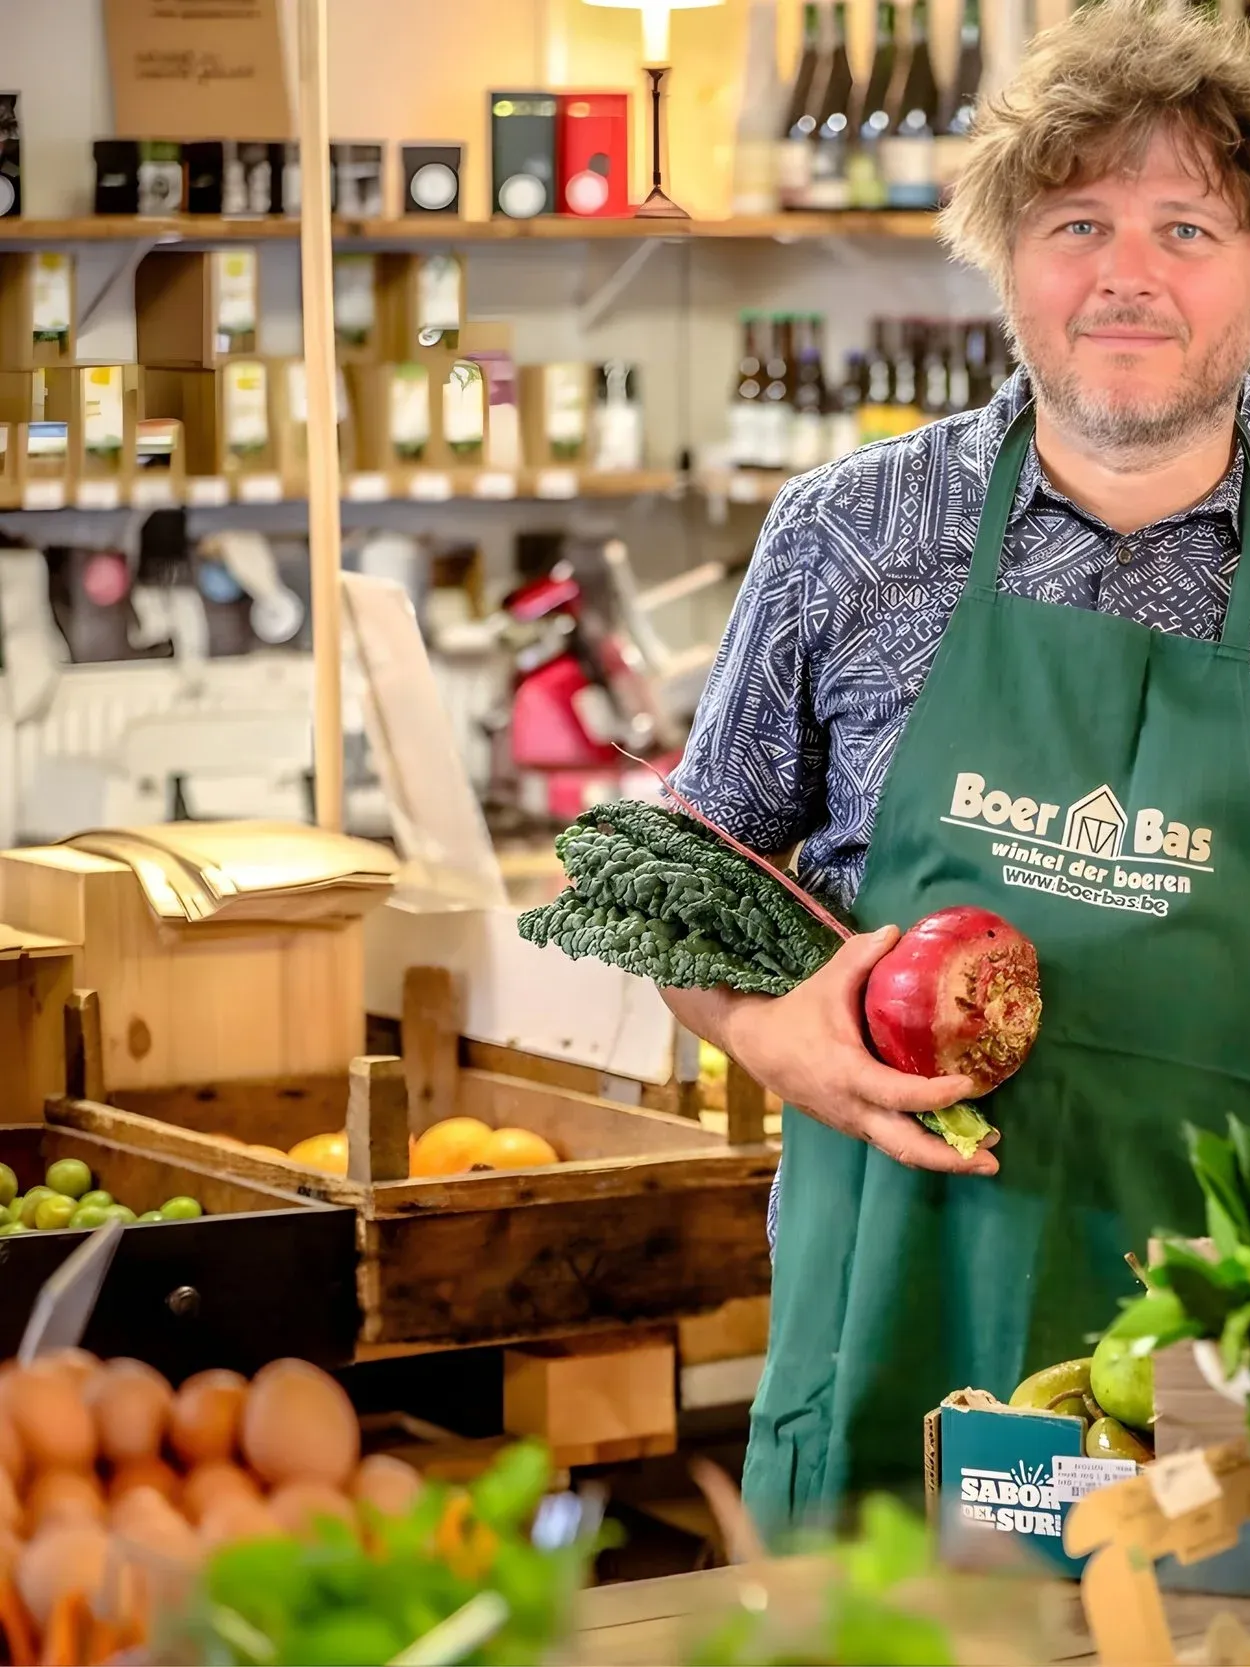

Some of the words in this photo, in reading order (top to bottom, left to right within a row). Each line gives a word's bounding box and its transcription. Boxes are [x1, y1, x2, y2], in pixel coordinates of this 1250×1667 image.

[950, 773, 1060, 836] Boer
[1134, 808, 1213, 862] Bas
[992, 841, 1065, 871] winkel
[1068, 859, 1109, 883] der
[1113, 865, 1191, 893] boeren
[1005, 867, 1167, 914] www.boerbas.be
[961, 1477, 1061, 1511] SABOR
[962, 1504, 996, 1522] DEL
